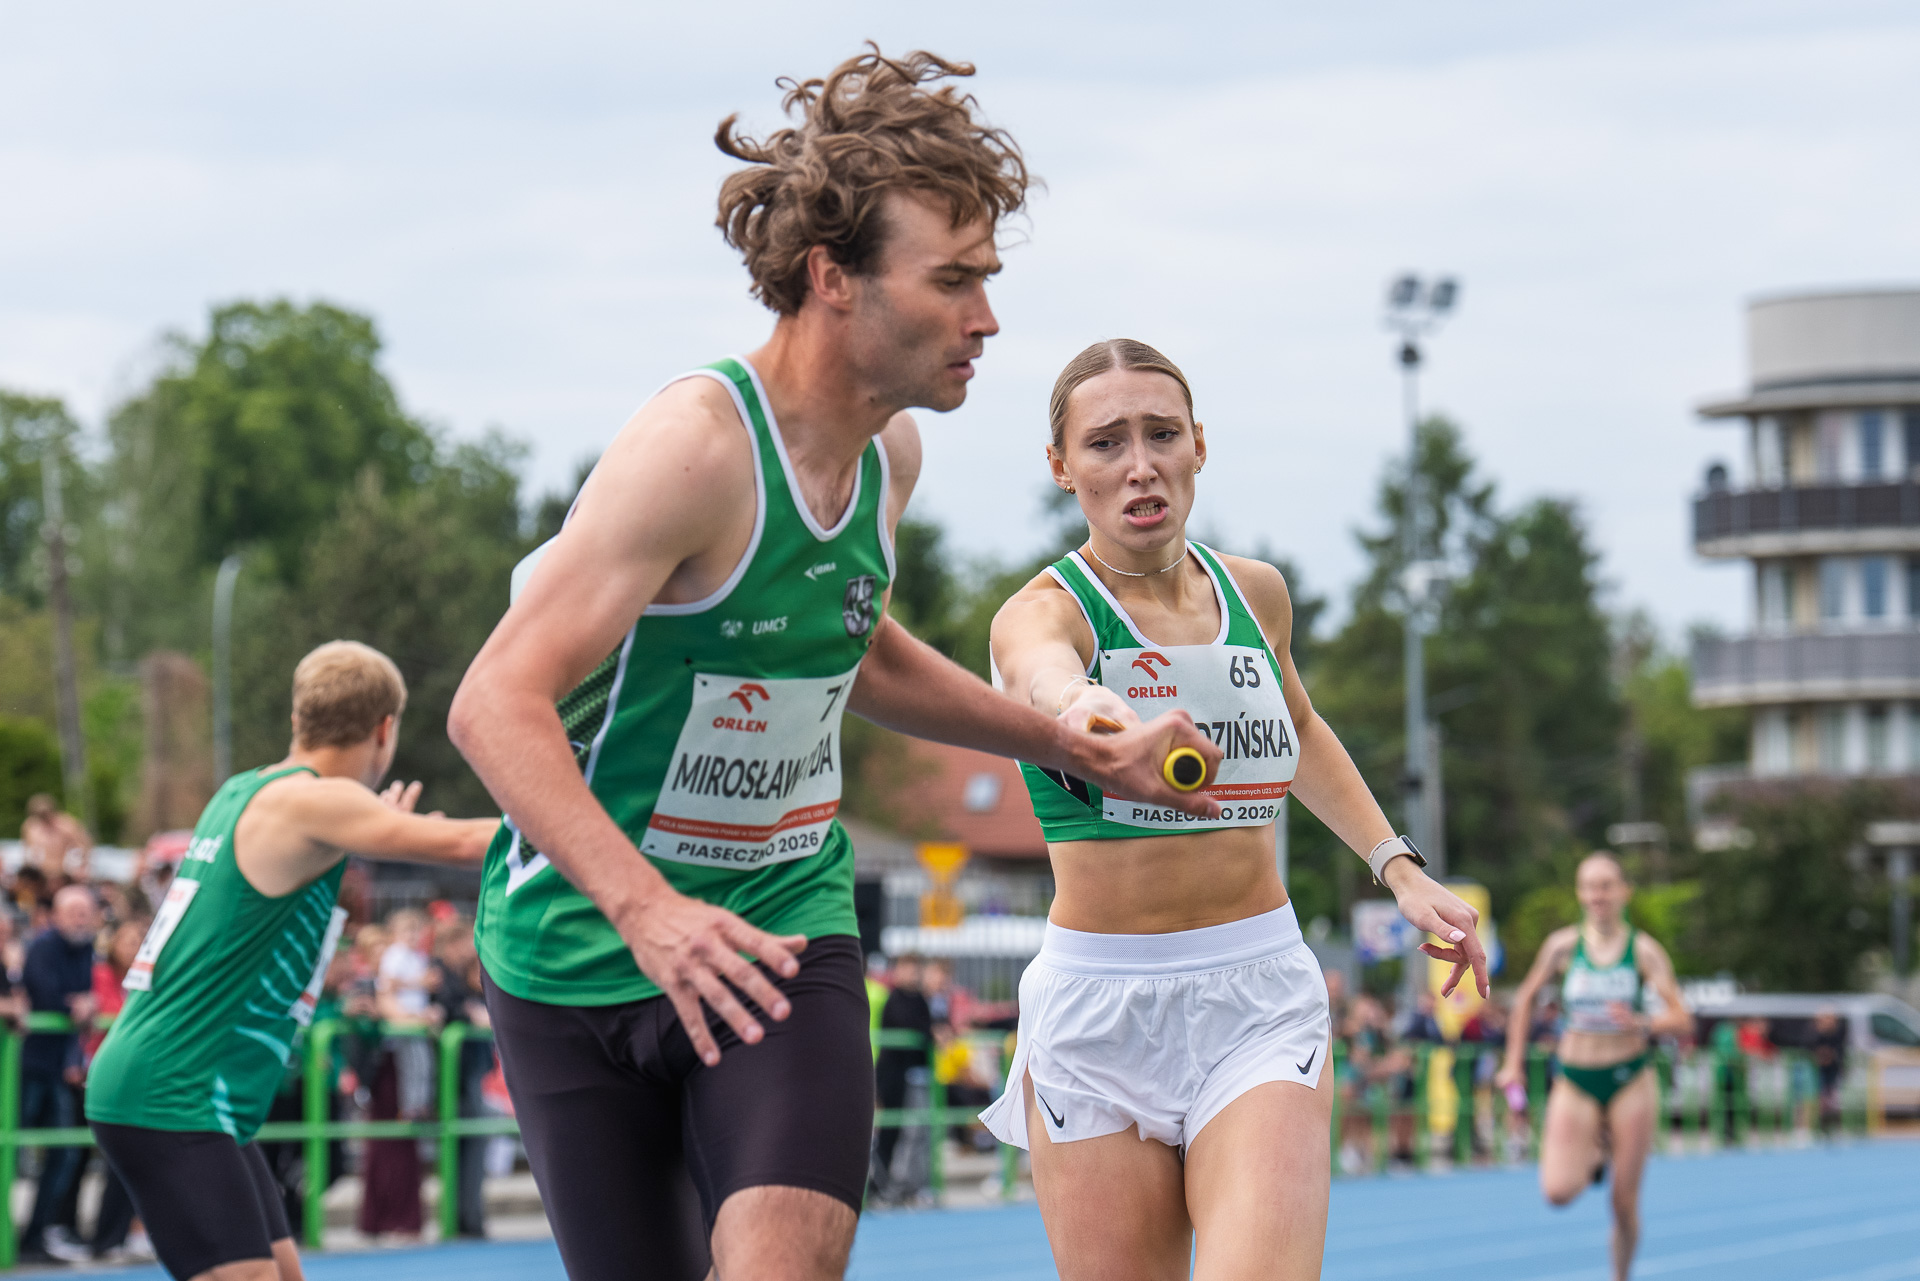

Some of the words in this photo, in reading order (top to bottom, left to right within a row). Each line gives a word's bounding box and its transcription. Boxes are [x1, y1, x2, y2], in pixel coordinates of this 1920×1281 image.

[752, 616, 788, 635] UMCS
[1229, 655, 1261, 689] 65
[1127, 685, 1177, 699] ORLEN
[712, 716, 768, 733] ORLEN
[1224, 788, 1261, 796] Mieszanych
[1132, 807, 1233, 822] PIASECO
[1237, 805, 1274, 820] 2026
[676, 842, 775, 864] PIASECZNO
[778, 832, 819, 853] 2026
